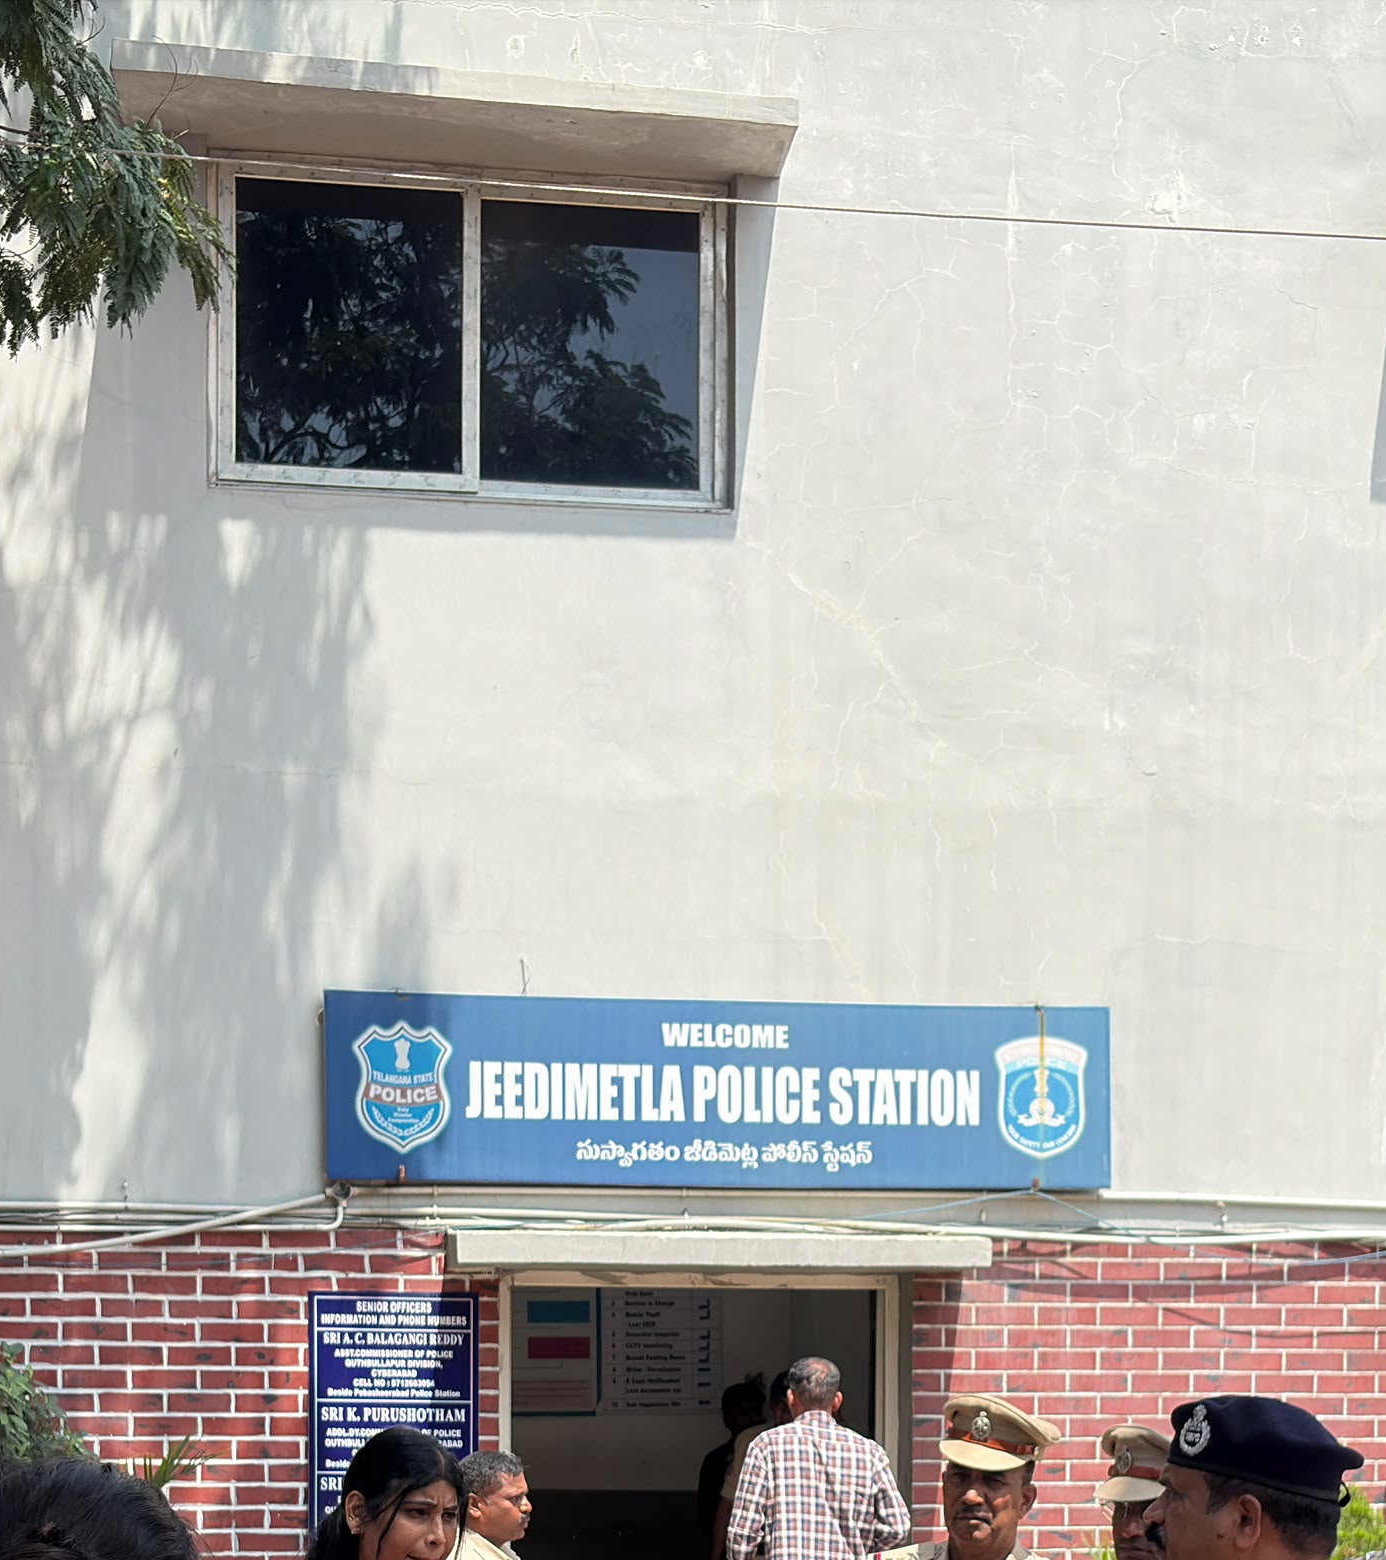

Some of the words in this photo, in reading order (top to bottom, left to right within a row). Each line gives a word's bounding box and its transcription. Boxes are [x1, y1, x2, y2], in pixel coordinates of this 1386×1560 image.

[661, 1023, 789, 1049] WELCOME
[413, 1071, 434, 1084] STATE
[369, 1083, 438, 1104] POLICE
[465, 1060, 686, 1122] JEEDIMETLA
[693, 1065, 821, 1124] POLICE
[829, 1067, 980, 1127] STATION
[576, 1138, 680, 1167] సుస్వాగతం
[684, 1139, 759, 1169] జీడిమెట్ల
[762, 1141, 819, 1164] పోలీస్
[823, 1140, 873, 1172] స్టేషన్
[356, 1301, 389, 1313] SENIOR
[389, 1301, 432, 1313] OFFICERS
[321, 1314, 377, 1325] INFORMATION
[379, 1314, 396, 1325] AND
[398, 1315, 426, 1326] PHONE
[427, 1315, 467, 1326] NUMBERS
[323, 1332, 341, 1344] SRI
[430, 1333, 464, 1346] REDDY
[414, 1349, 425, 1358] OF
[426, 1350, 453, 1359] POLICE
[371, 1369, 417, 1378] CYBERABAD
[353, 1378, 373, 1387] CELL
[374, 1379, 385, 1387] NO
[434, 1389, 460, 1398] Station
[321, 1407, 343, 1421] SRI
[346, 1407, 361, 1422] K.
[363, 1407, 466, 1422] PURUSHOTHAM
[434, 1429, 461, 1438] POLICE
[320, 1476, 343, 1491] SRI
